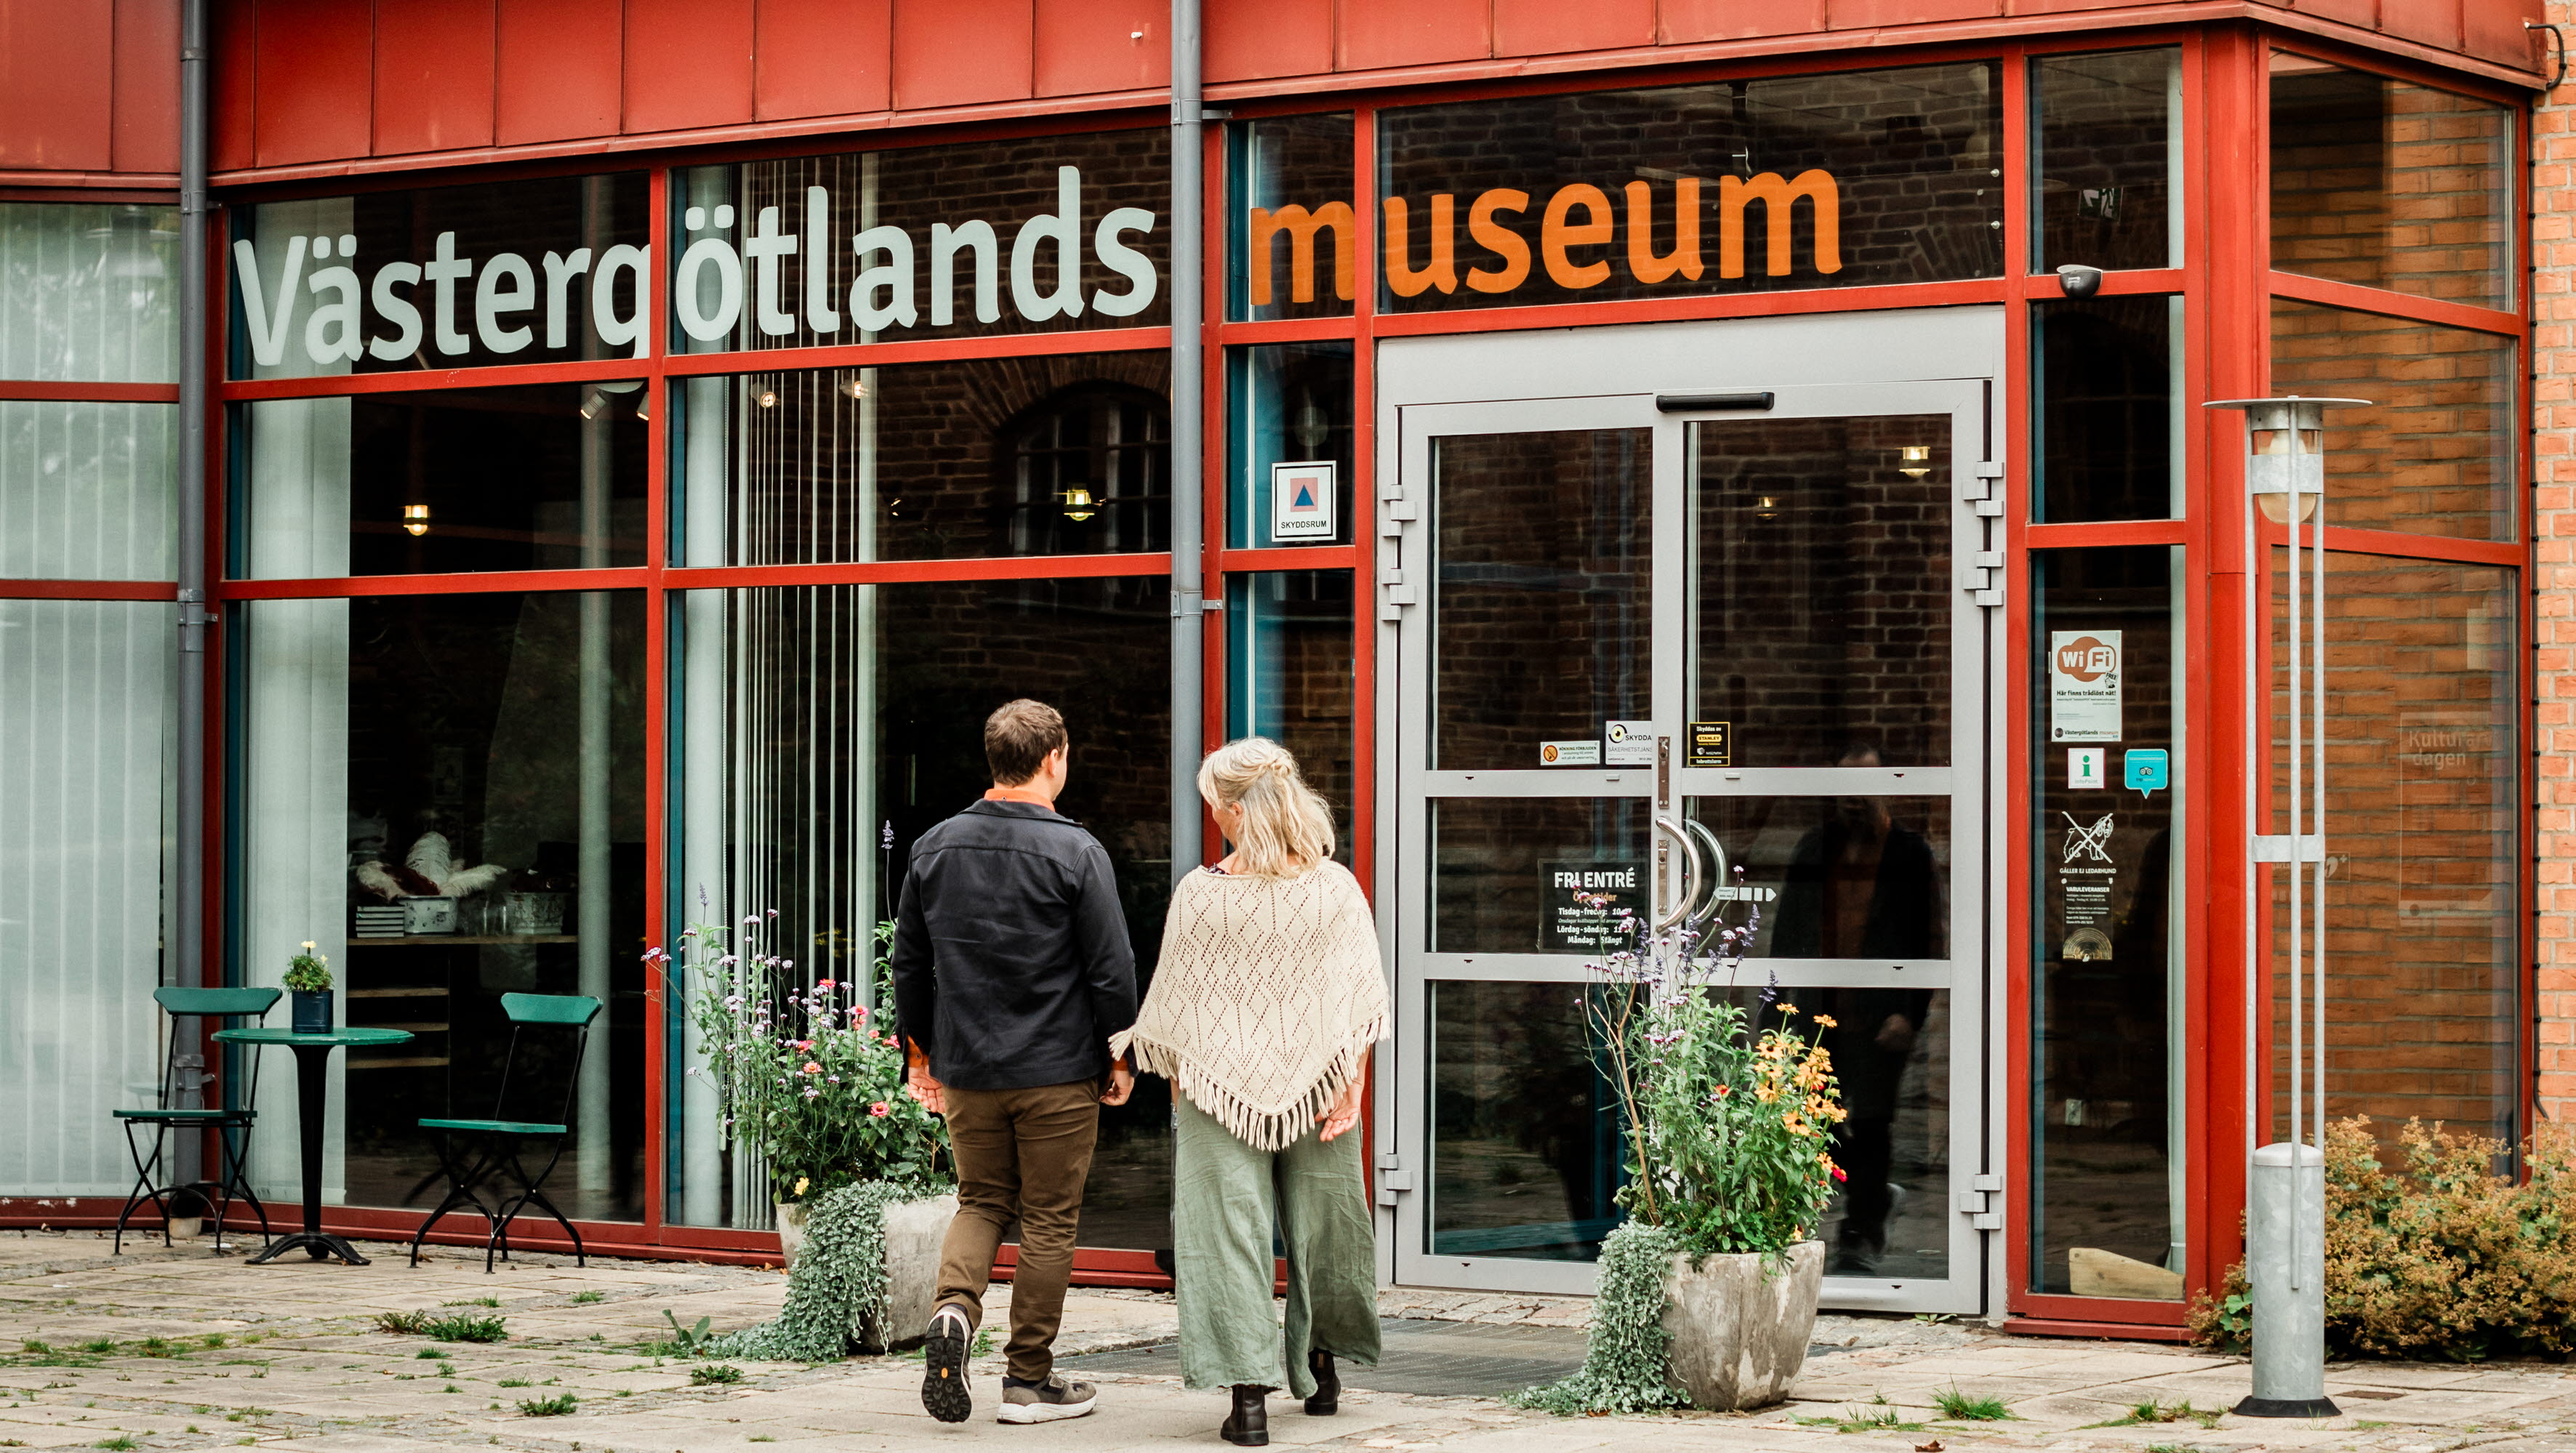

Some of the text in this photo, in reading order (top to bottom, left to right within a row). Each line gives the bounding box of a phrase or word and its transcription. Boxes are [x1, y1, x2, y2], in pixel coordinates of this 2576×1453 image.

[233, 165, 1842, 366] Västergötlands museum
[1280, 520, 1327, 529] SKYDDSRUM
[2106, 672, 2117, 681] FREE
[2413, 747, 2466, 770] dagen
[1584, 866, 1636, 888] ENTRÉ
[1567, 935, 1623, 946] Måndag: Stängt
